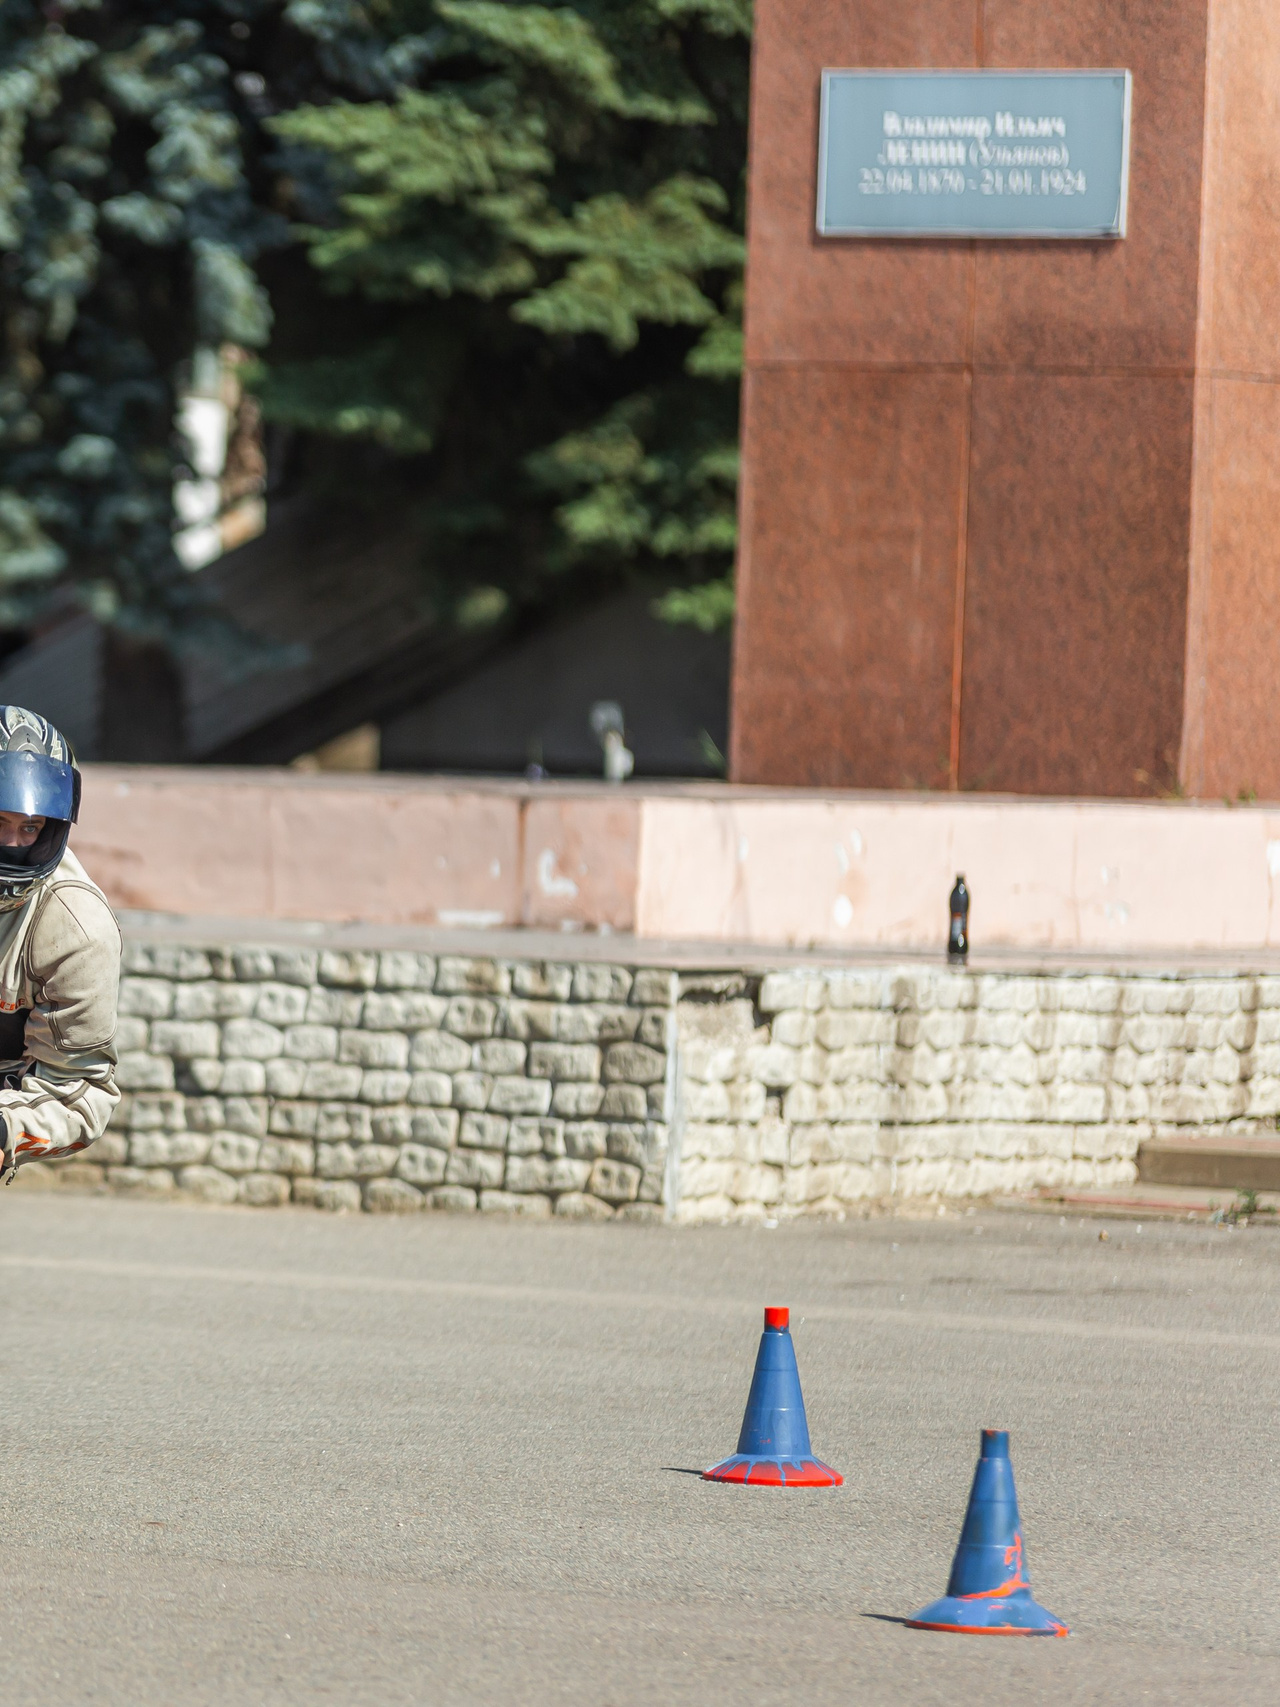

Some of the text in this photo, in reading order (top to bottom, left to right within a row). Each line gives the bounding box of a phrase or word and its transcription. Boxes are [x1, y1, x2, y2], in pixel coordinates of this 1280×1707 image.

[995, 111, 1066, 137] Ильич
[877, 139, 967, 166] ЛЕНИН
[980, 168, 1087, 195] 21.01.1924
